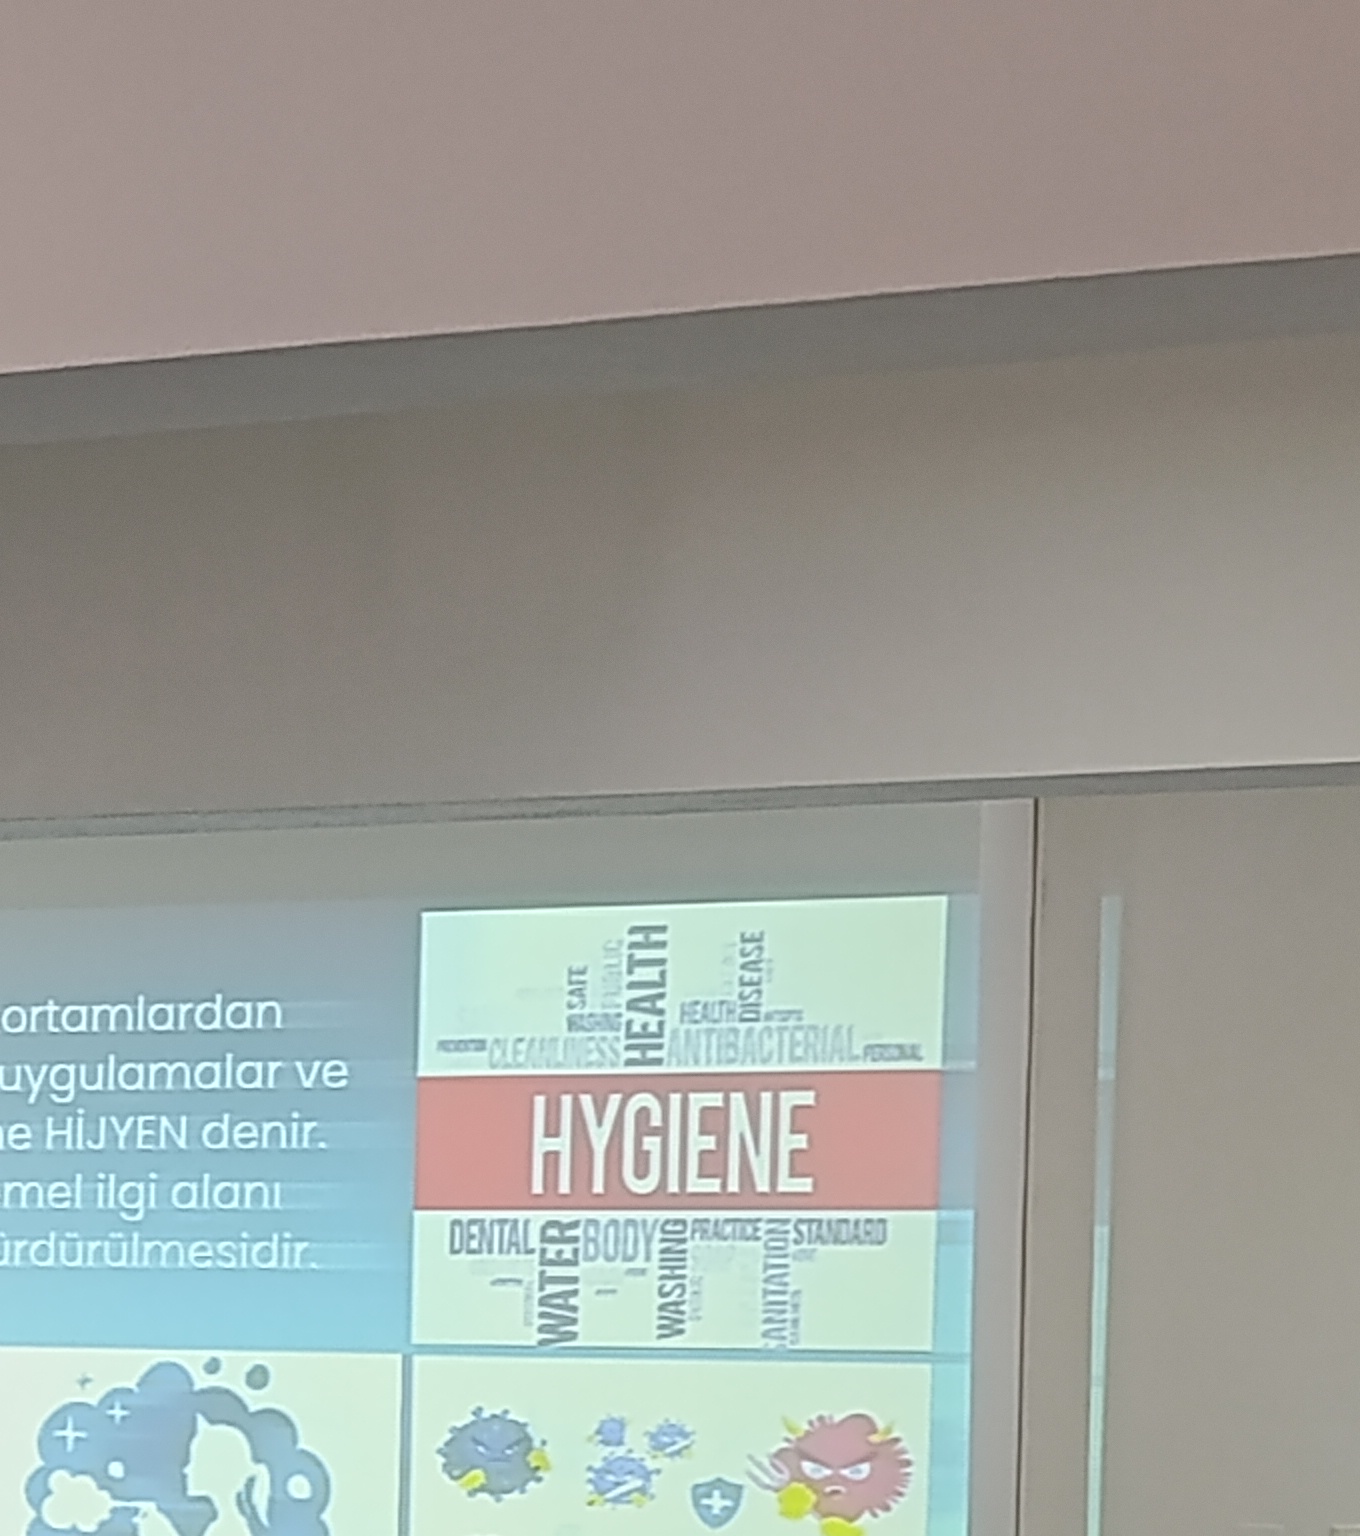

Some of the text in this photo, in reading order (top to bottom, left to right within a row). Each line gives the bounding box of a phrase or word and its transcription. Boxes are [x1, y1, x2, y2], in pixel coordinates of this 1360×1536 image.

[567, 965, 588, 1010] SAFE
[624, 925, 668, 1067] HEALTH
[738, 930, 765, 1023] DISEASE
[1, 994, 283, 1034] ortamlardan
[488, 1036, 621, 1069] CLEANLINESS
[667, 1024, 861, 1066] ANTIBACTERIAL
[295, 1059, 349, 1089] ve
[45, 1108, 188, 1150] HİJYEN
[201, 1111, 328, 1149] denir.
[531, 1090, 816, 1194] HYGIENE
[95, 1172, 159, 1221] ilgi
[171, 1173, 282, 1209] alanı
[449, 1218, 536, 1254] DENTAL
[582, 1218, 659, 1262] BODY
[537, 1219, 581, 1346] WATER
[656, 1218, 688, 1340] WASHING
